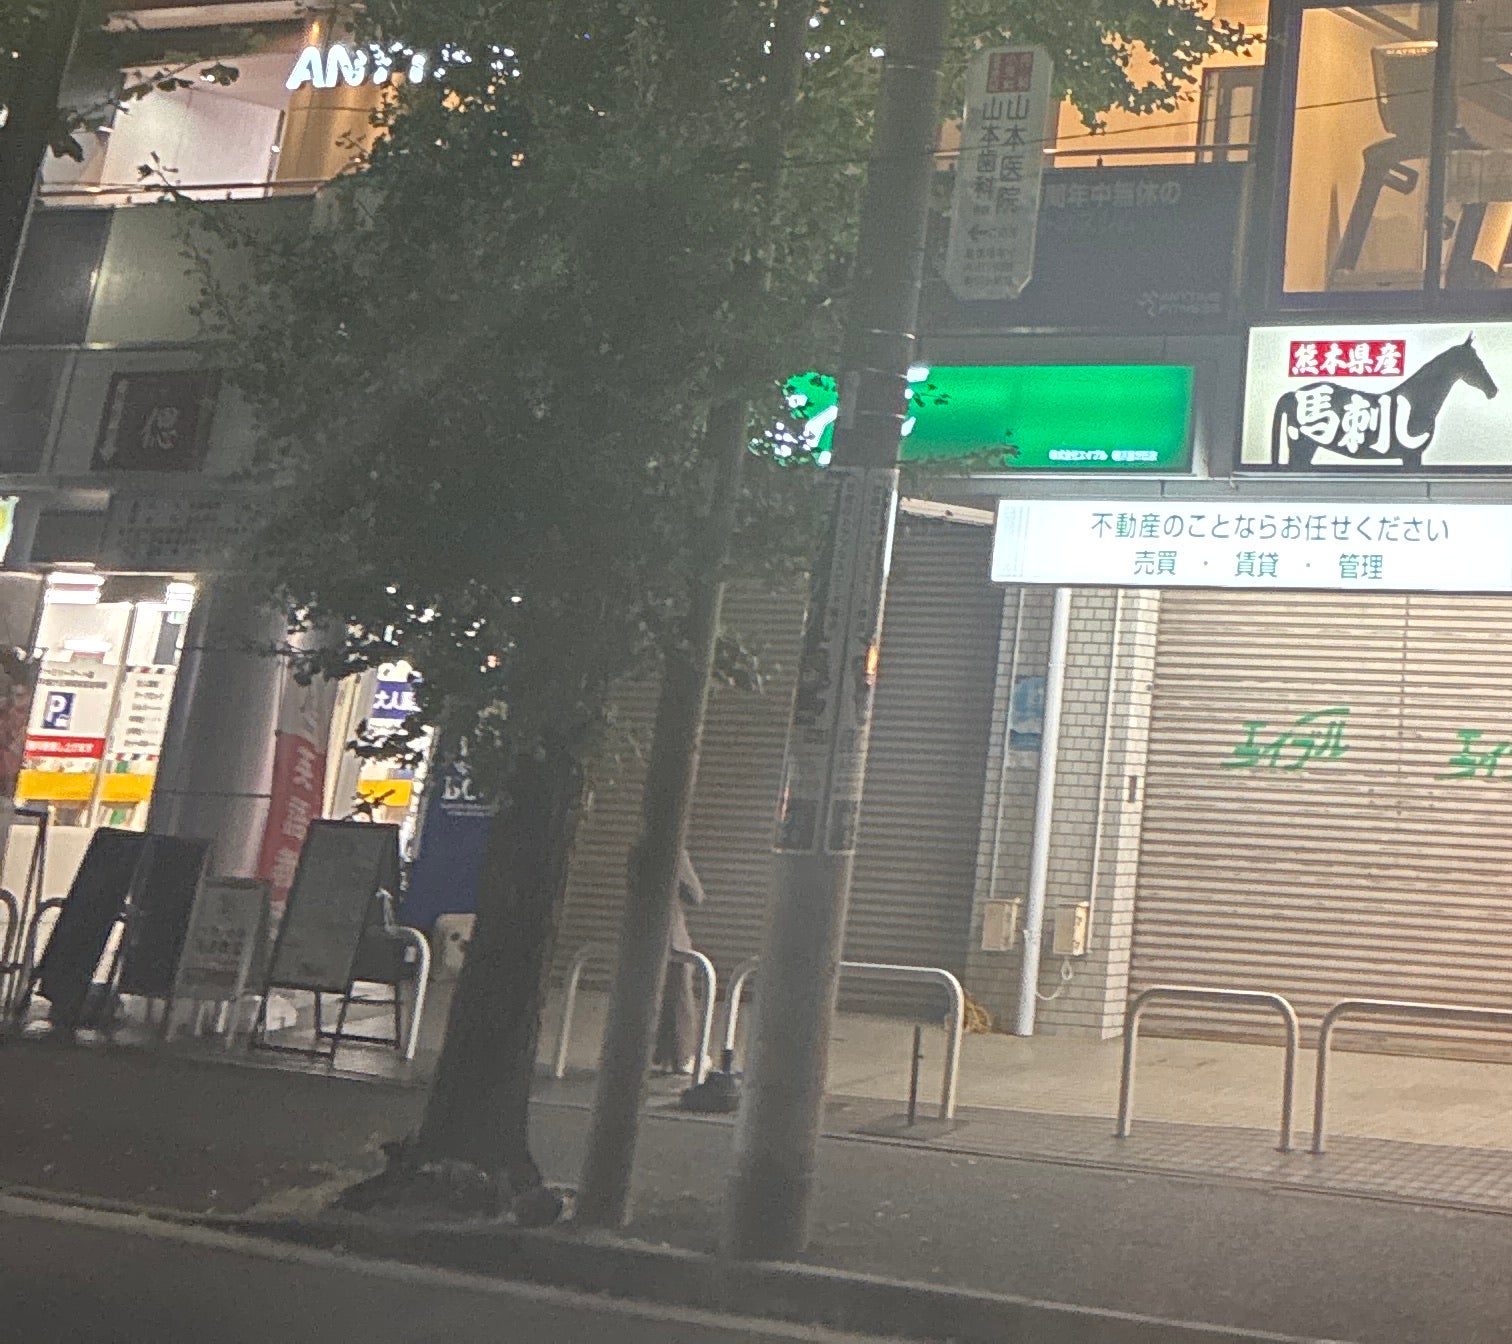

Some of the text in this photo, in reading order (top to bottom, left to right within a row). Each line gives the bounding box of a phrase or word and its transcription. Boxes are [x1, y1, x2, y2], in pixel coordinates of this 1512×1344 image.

[1000, 94, 1030, 213] 山本医院
[1292, 342, 1402, 375] 熊本県産
[1287, 384, 1431, 454] 馬刺し
[1091, 512, 1449, 543] 不動産のことならお任せください
[1133, 550, 1383, 579] 売買 賃貸 管理
